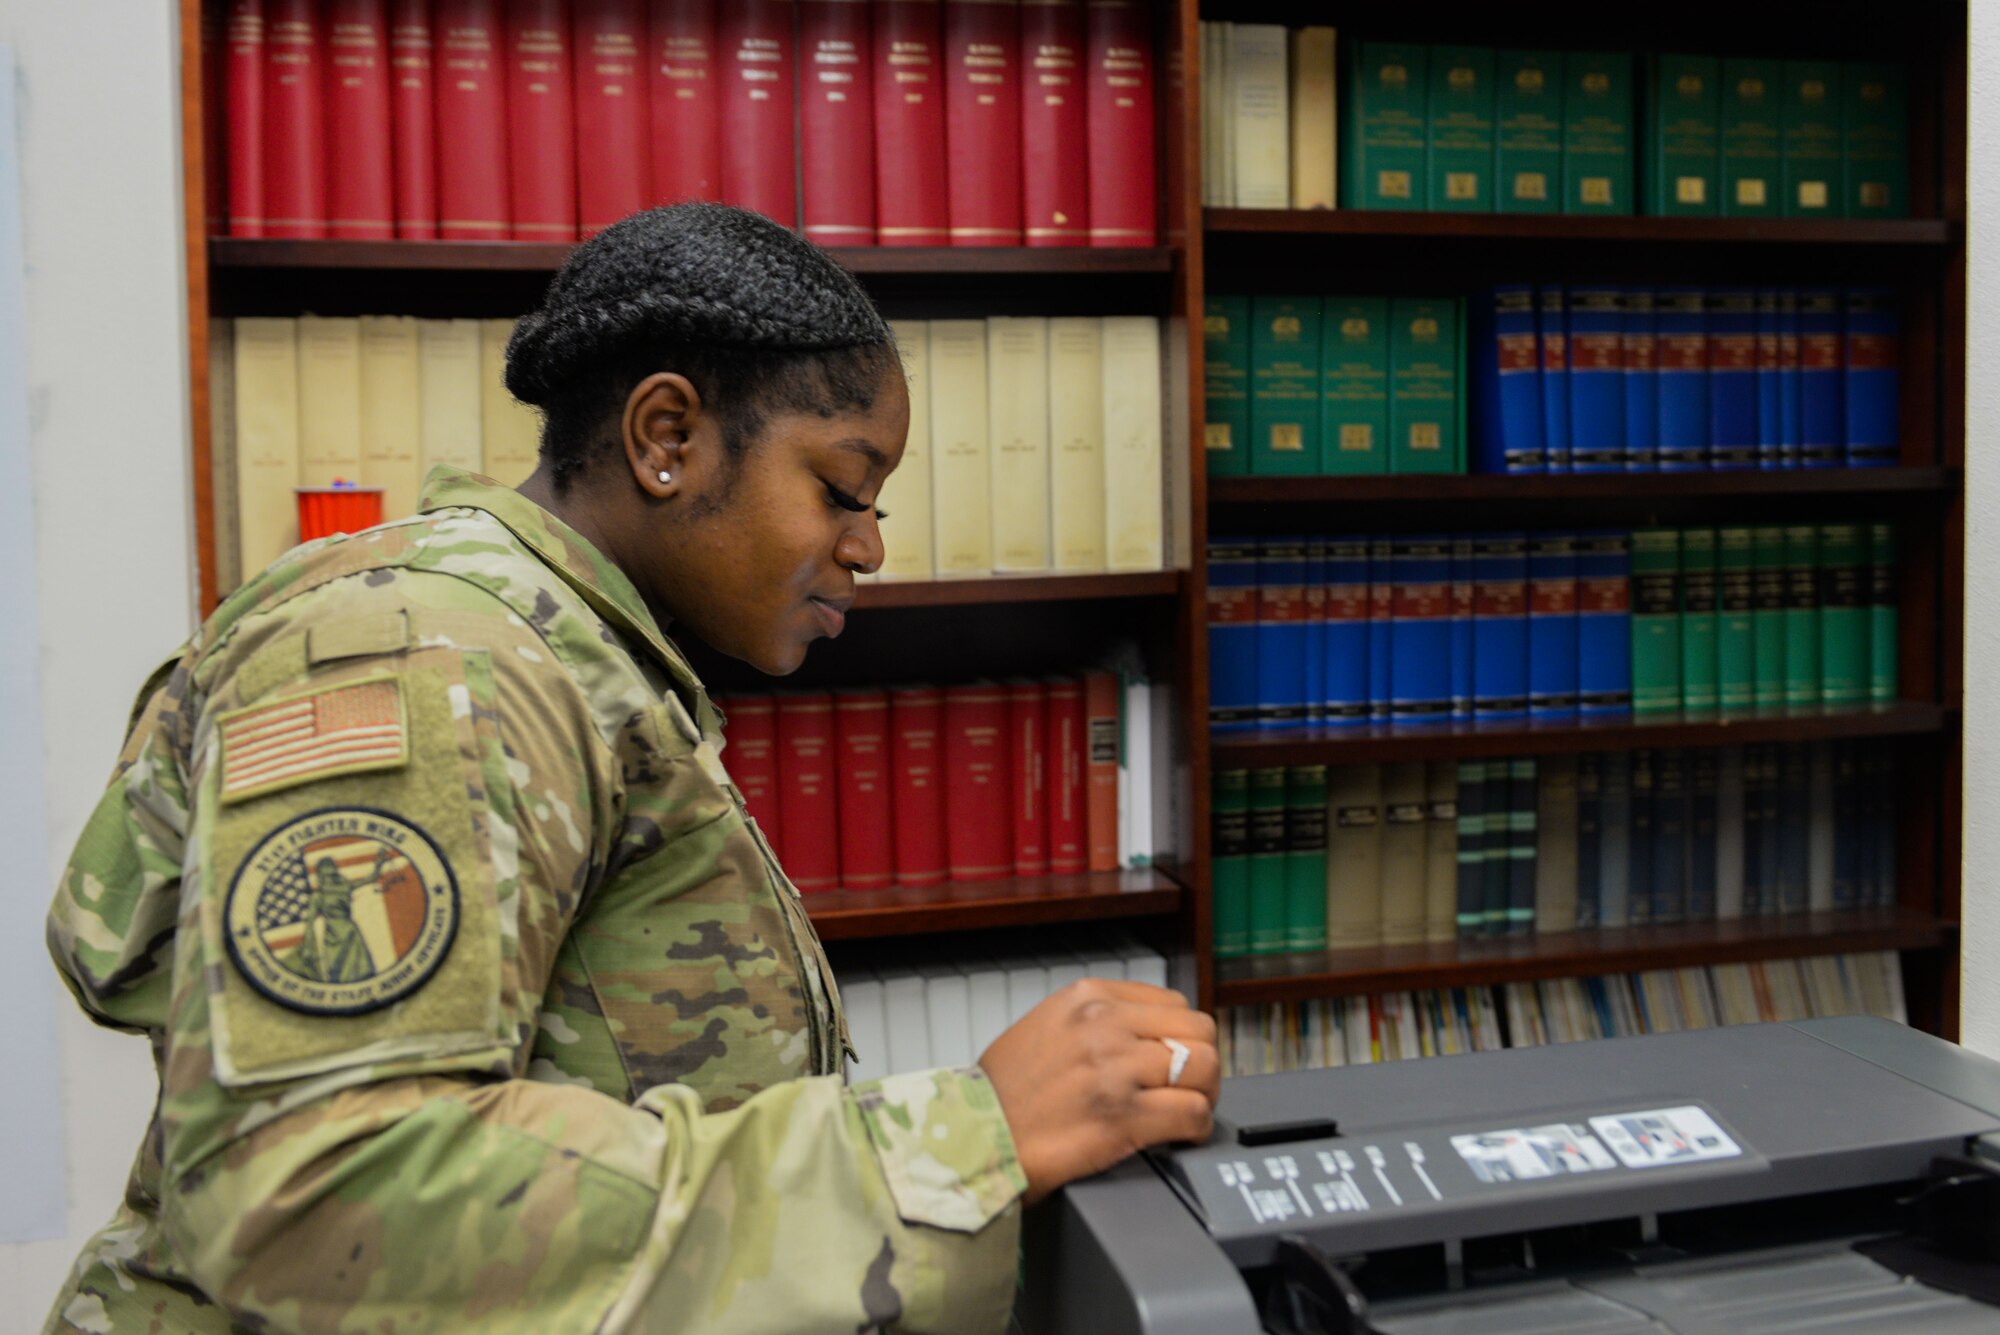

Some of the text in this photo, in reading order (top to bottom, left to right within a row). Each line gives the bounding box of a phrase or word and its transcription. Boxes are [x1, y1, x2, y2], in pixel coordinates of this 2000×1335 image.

[288, 818, 359, 846] FIGHTER
[366, 821, 405, 844] WING
[283, 980, 299, 991] OF
[303, 987, 325, 999] THE
[331, 986, 372, 1000] STAFF
